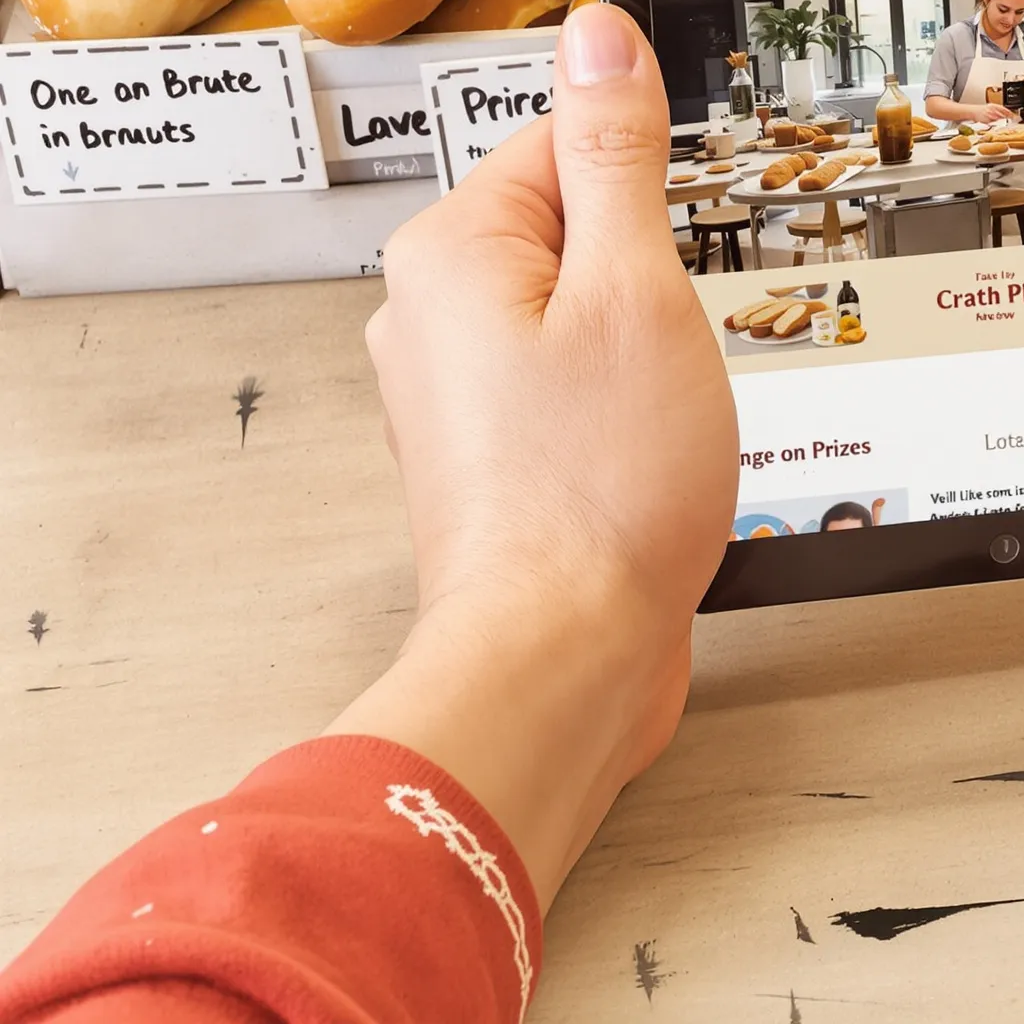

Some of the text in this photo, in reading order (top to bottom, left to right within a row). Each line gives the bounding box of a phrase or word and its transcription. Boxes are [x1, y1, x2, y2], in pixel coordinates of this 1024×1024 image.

[30, 78, 98, 110] One
[162, 67, 262, 102] Brute
[40, 122, 71, 150] in
[341, 103, 432, 147] Lave
[936, 286, 1000, 309] Crath
[781, 447, 806, 462] on
[812, 439, 872, 459] Prizes
